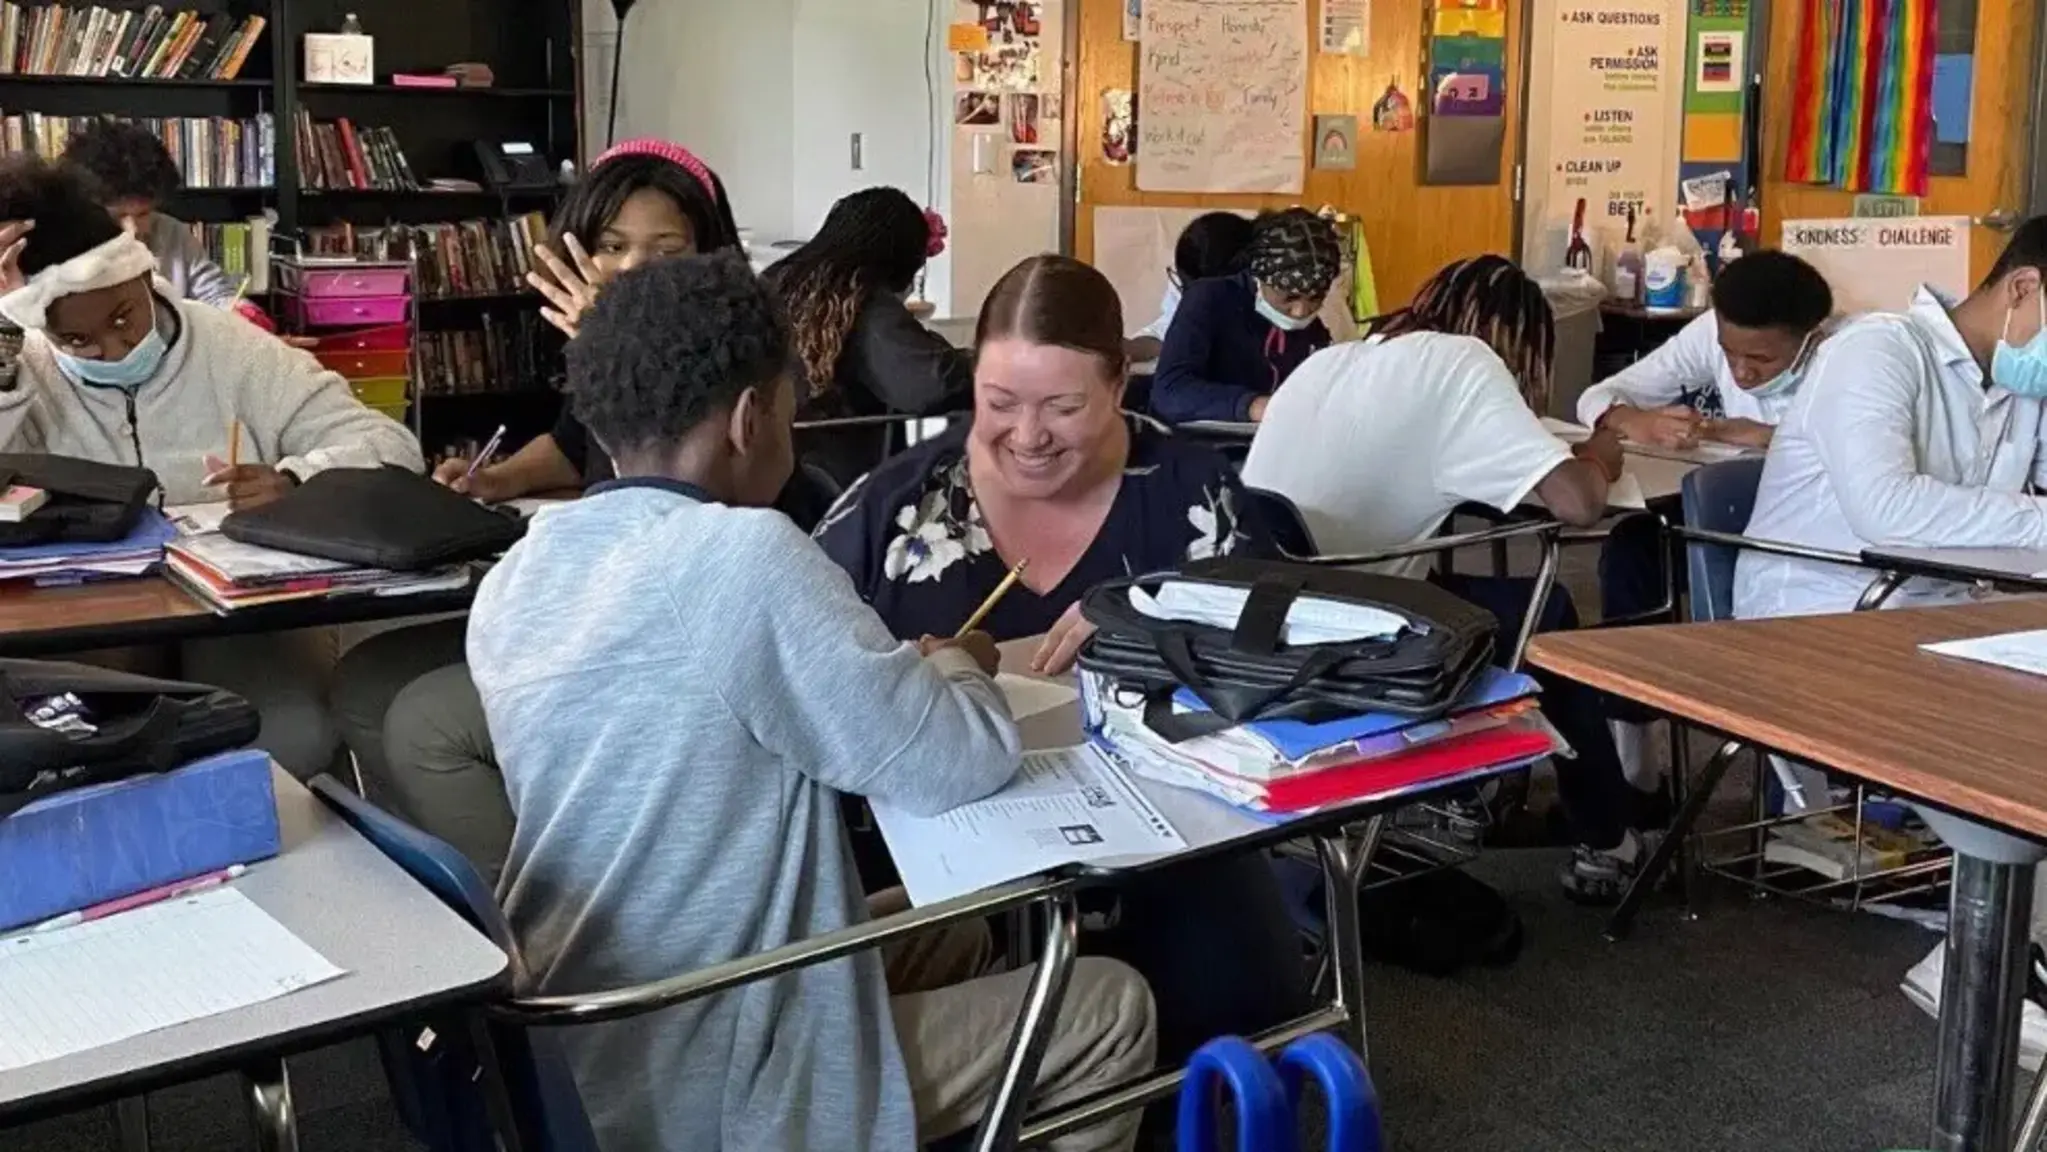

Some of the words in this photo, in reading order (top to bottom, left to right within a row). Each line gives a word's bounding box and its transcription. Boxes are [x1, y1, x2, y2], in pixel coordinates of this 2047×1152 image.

[1571, 12, 1594, 24] ASK
[1597, 12, 1660, 25] QUESTIONS
[1636, 46, 1658, 57] ASK
[1590, 57, 1658, 70] PERMISSION
[1594, 110, 1633, 122] LISTEN
[1565, 161, 1603, 173] CLEAN
[1606, 161, 1622, 172] UP
[1608, 201, 1644, 216] BEST
[1795, 228, 1860, 245] KINDNESS
[1878, 226, 1953, 245] CHALLENGE
